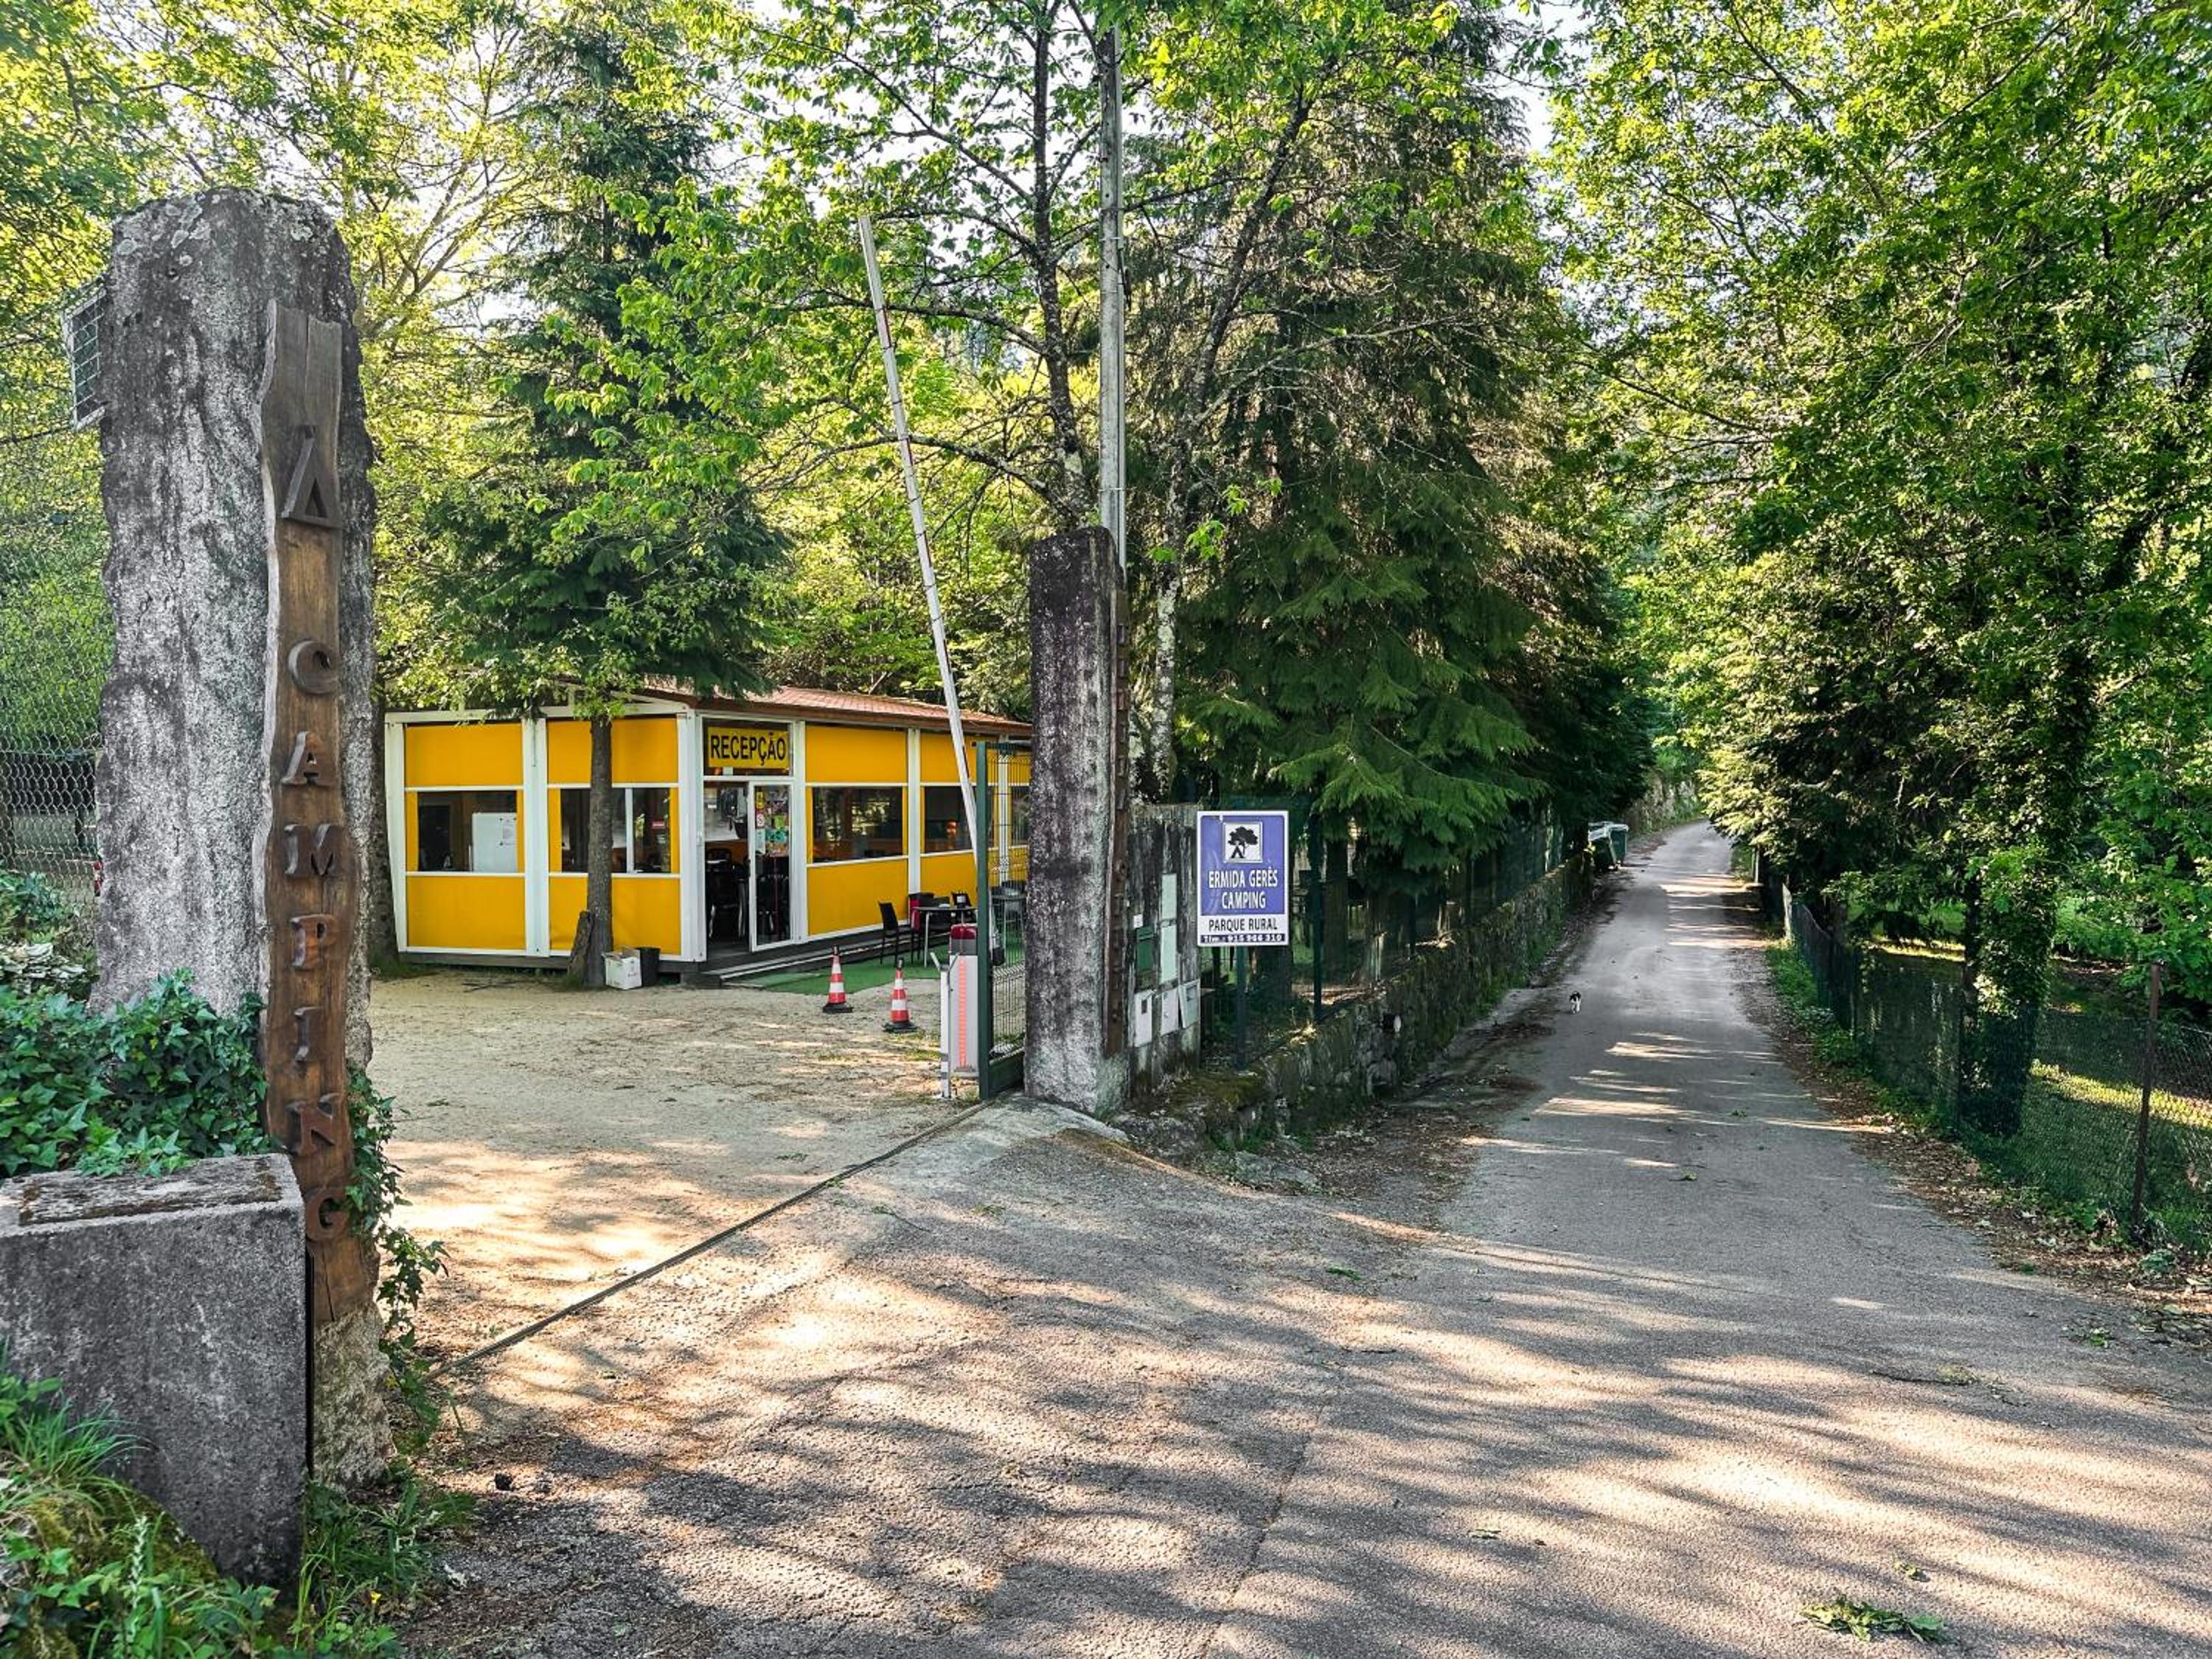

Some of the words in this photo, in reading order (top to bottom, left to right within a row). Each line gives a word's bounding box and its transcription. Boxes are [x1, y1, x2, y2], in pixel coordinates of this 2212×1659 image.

[710, 732, 786, 765] RECEPÇÃO
[1208, 870, 1245, 888] ERMIDA
[1249, 866, 1278, 888] GERÊS
[1222, 891, 1266, 909] CAMPING
[1208, 918, 1245, 932] PARQUE
[1249, 917, 1278, 931] RURAL
[282, 636, 351, 1242] CAMPING
